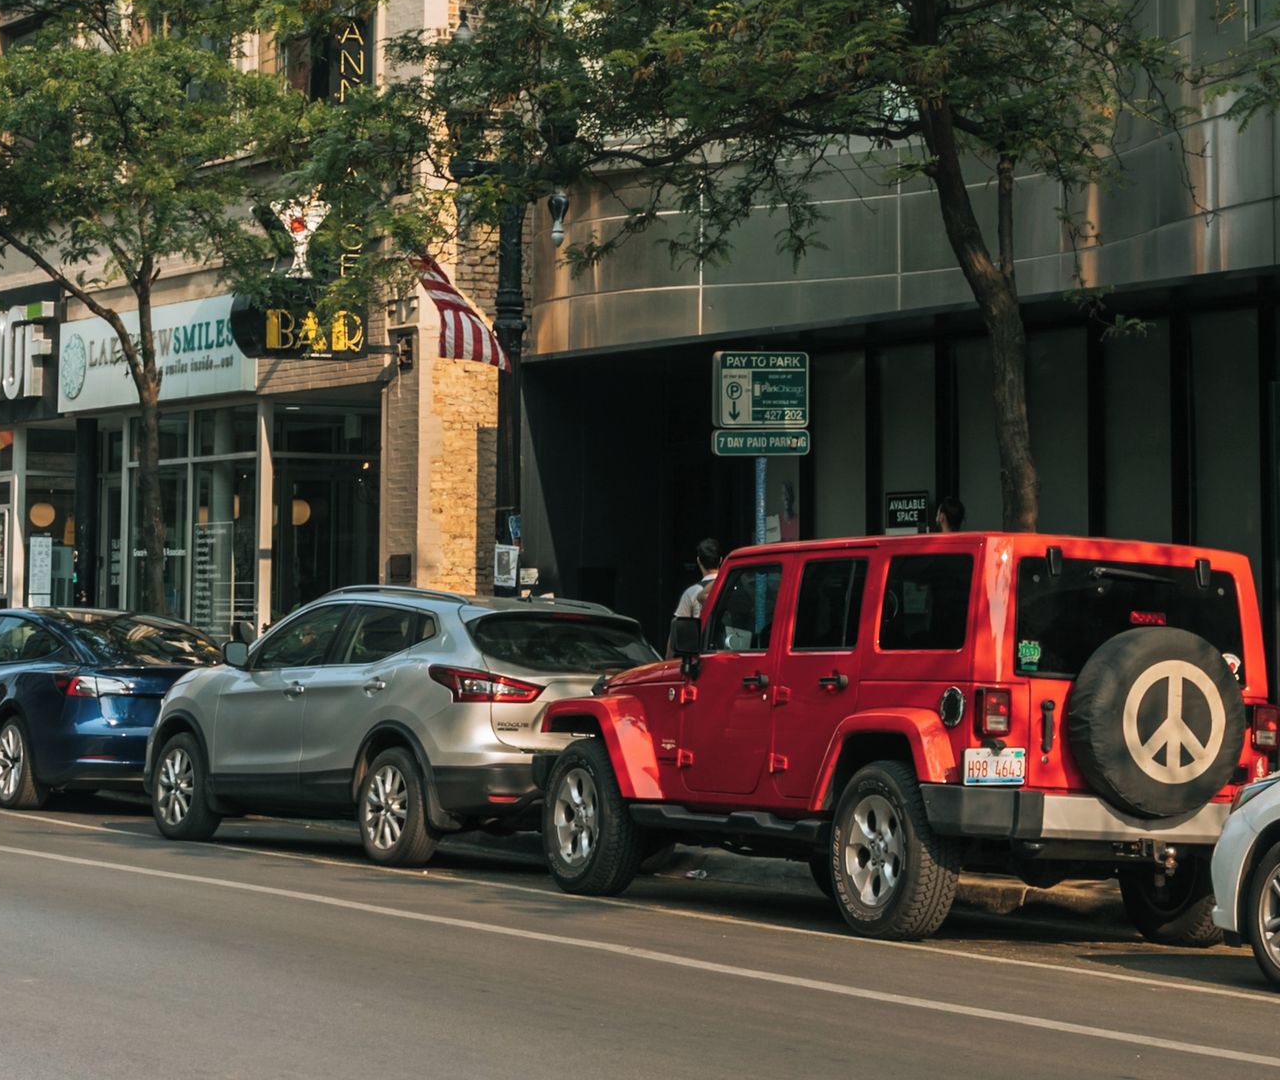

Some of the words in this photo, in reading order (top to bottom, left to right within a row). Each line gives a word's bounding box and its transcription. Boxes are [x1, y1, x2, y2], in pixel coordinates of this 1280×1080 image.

[265, 309, 365, 352] BAR
[726, 356, 749, 367] PAY
[750, 356, 767, 367] TO
[769, 356, 801, 367] PARK
[764, 410, 782, 420] 427
[784, 410, 802, 420] 202
[719, 437, 725, 448] 7
[727, 437, 746, 448] DAY
[746, 437, 767, 448] PAID
[889, 498, 926, 510] AVAILABLE
[896, 511, 919, 522] SPACE
[968, 760, 989, 778] H98
[995, 760, 1023, 778] 4643
